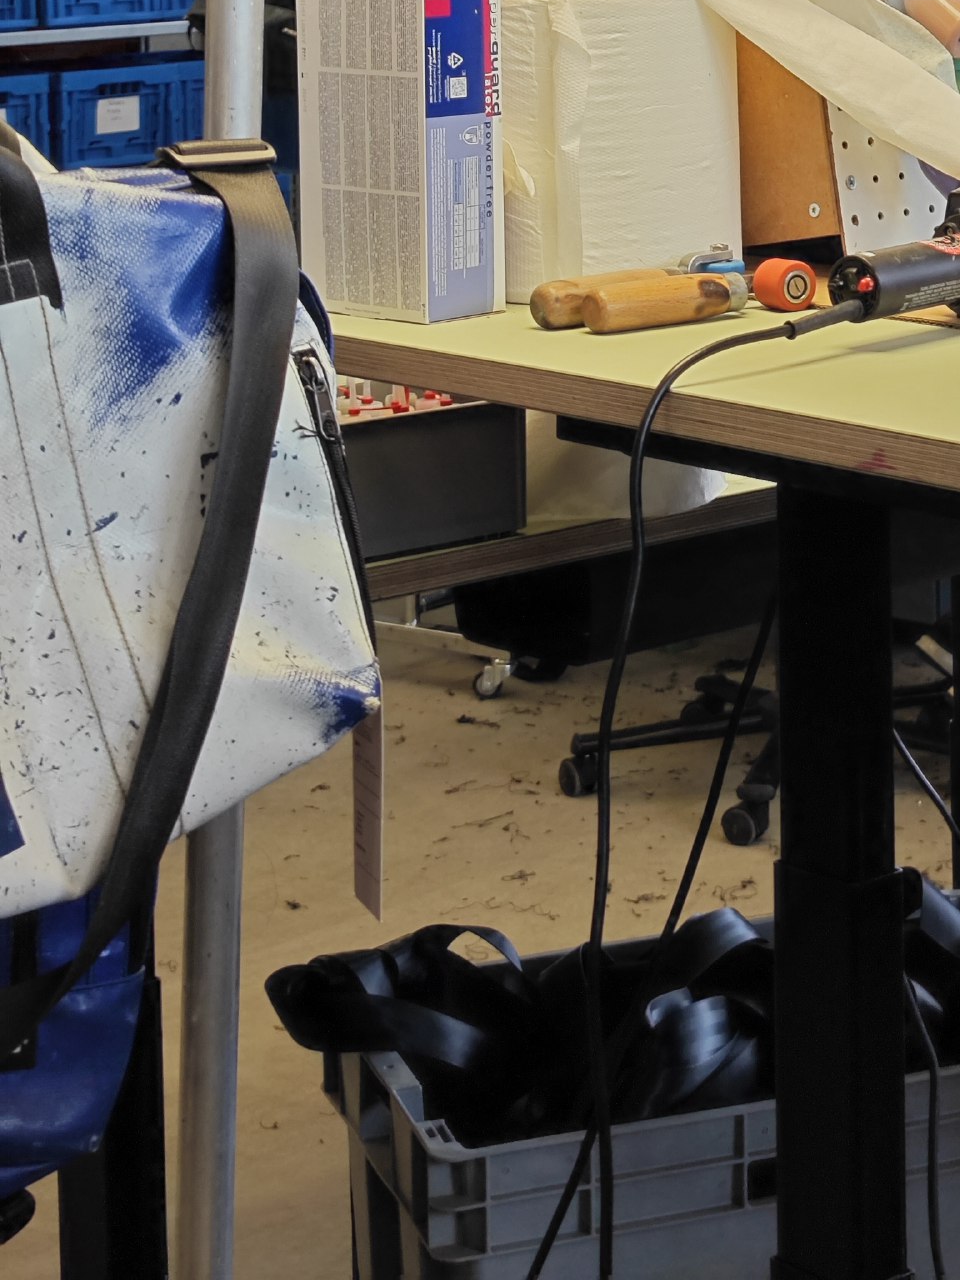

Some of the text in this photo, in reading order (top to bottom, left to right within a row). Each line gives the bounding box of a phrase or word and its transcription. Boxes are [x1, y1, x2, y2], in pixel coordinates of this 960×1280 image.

[485, 72, 494, 114] latex
[484, 121, 493, 219] powder free
